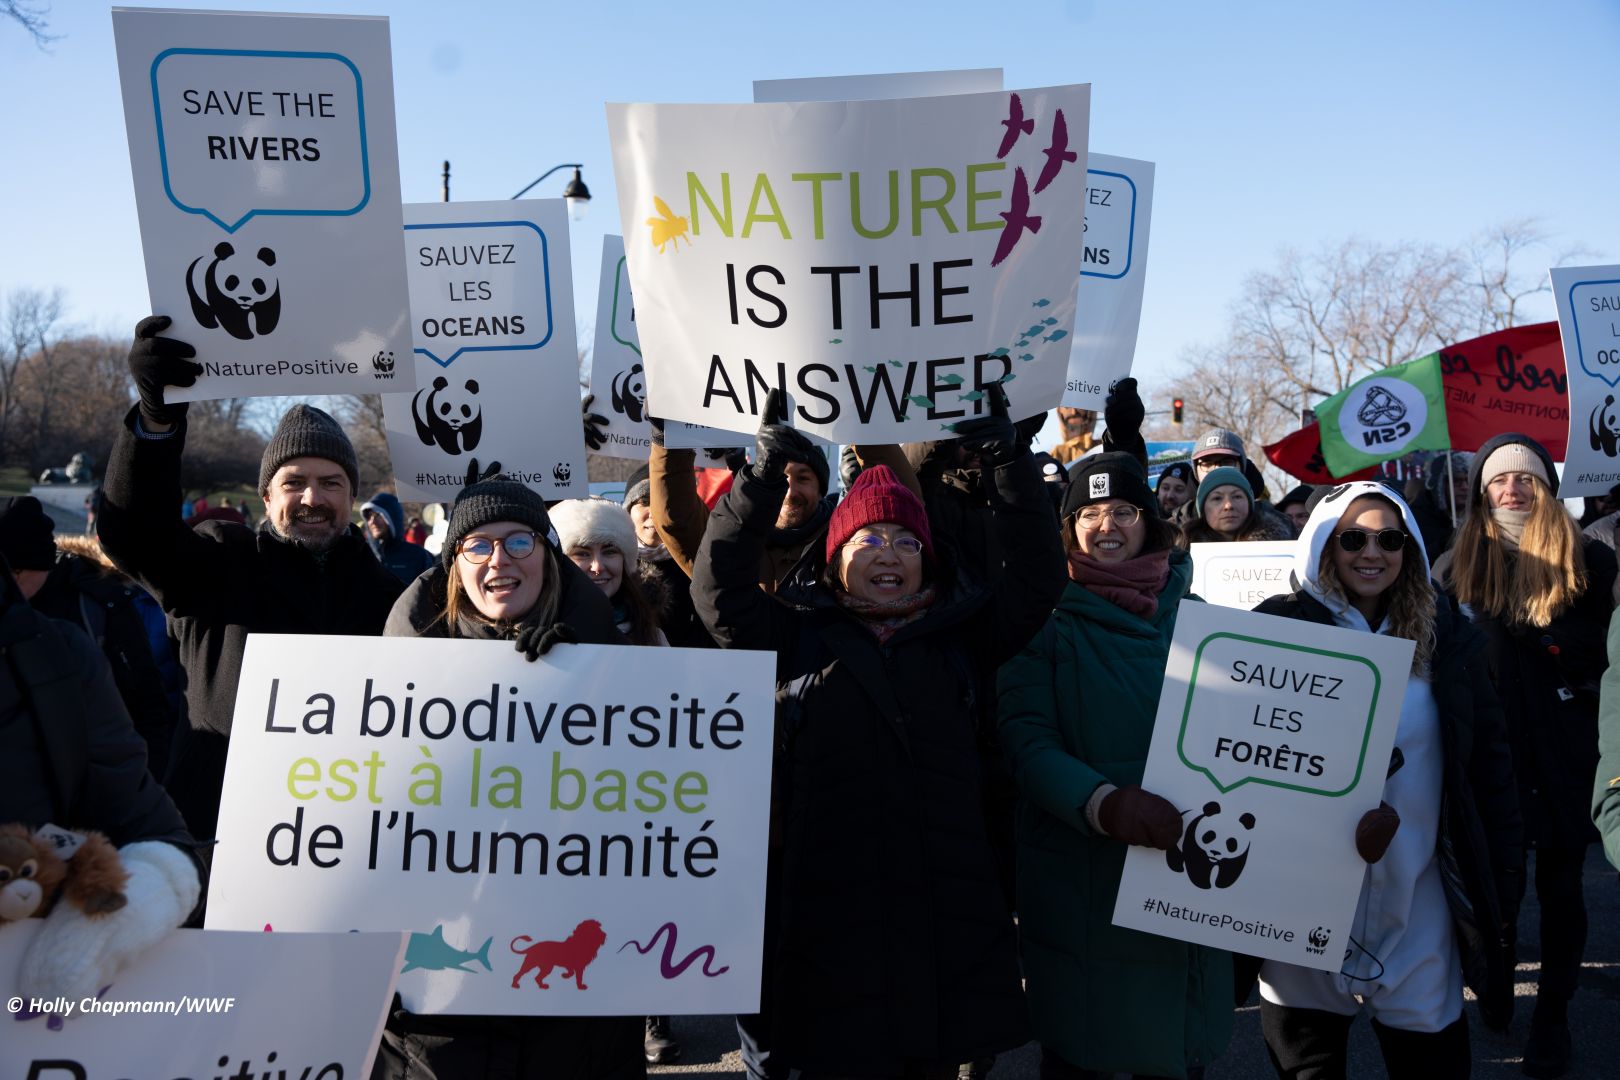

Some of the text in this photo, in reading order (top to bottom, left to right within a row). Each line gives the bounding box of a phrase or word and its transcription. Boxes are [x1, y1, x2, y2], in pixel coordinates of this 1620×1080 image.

[183, 89, 335, 118] SAVE THE
[207, 135, 321, 162] RIVERS
[686, 161, 1007, 240] NATURE
[1086, 188, 1112, 207] EZ
[419, 244, 516, 267] SAUVEZ
[449, 281, 492, 302] LES
[726, 258, 974, 330] IS THE
[422, 315, 525, 338] OCEANS
[201, 359, 359, 377] NaturePositive
[702, 353, 1013, 425] ANSWER
[1222, 568, 1283, 581] SAUVEZ
[1238, 590, 1266, 603] LES
[1230, 660, 1344, 700] SAUVEZ
[264, 678, 745, 751] La biodiversité
[1253, 704, 1304, 733] LES
[1214, 737, 1326, 777] FORÊTS
[286, 745, 709, 814] est à la base
[265, 806, 719, 879] de l’humanité
[1143, 898, 1295, 943] #NaturePositive
[1305, 946, 1327, 956] WWF
